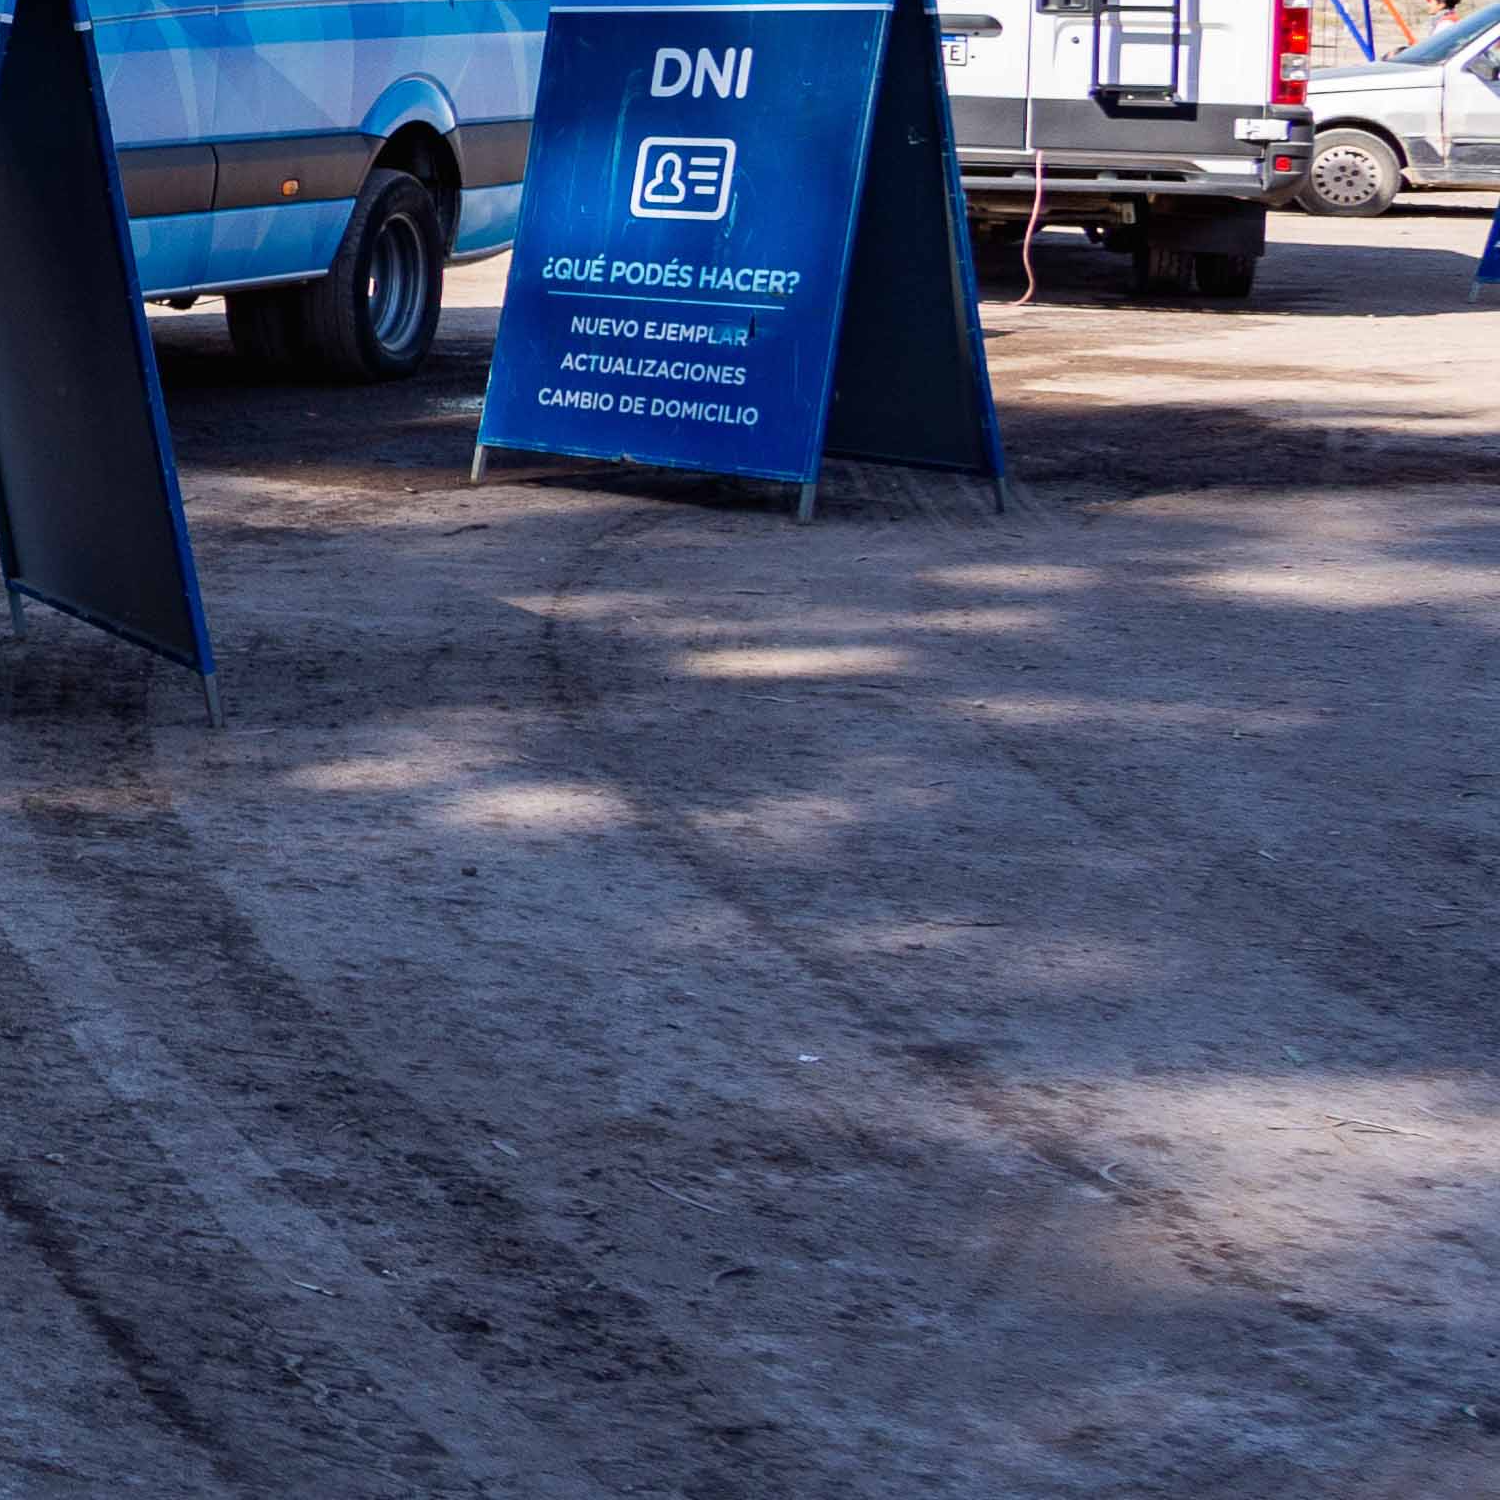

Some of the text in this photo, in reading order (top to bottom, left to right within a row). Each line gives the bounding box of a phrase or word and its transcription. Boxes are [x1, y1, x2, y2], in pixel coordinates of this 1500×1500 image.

[650, 48, 752, 99] DNI
[542, 254, 800, 294] ¿QUÉ PODÉS HACER?
[571, 316, 748, 347] NUEVO EJEMPLAR
[560, 352, 747, 385] ACTUALIZACIONES
[538, 387, 759, 426] CAMBIO DE DOMICILIO
